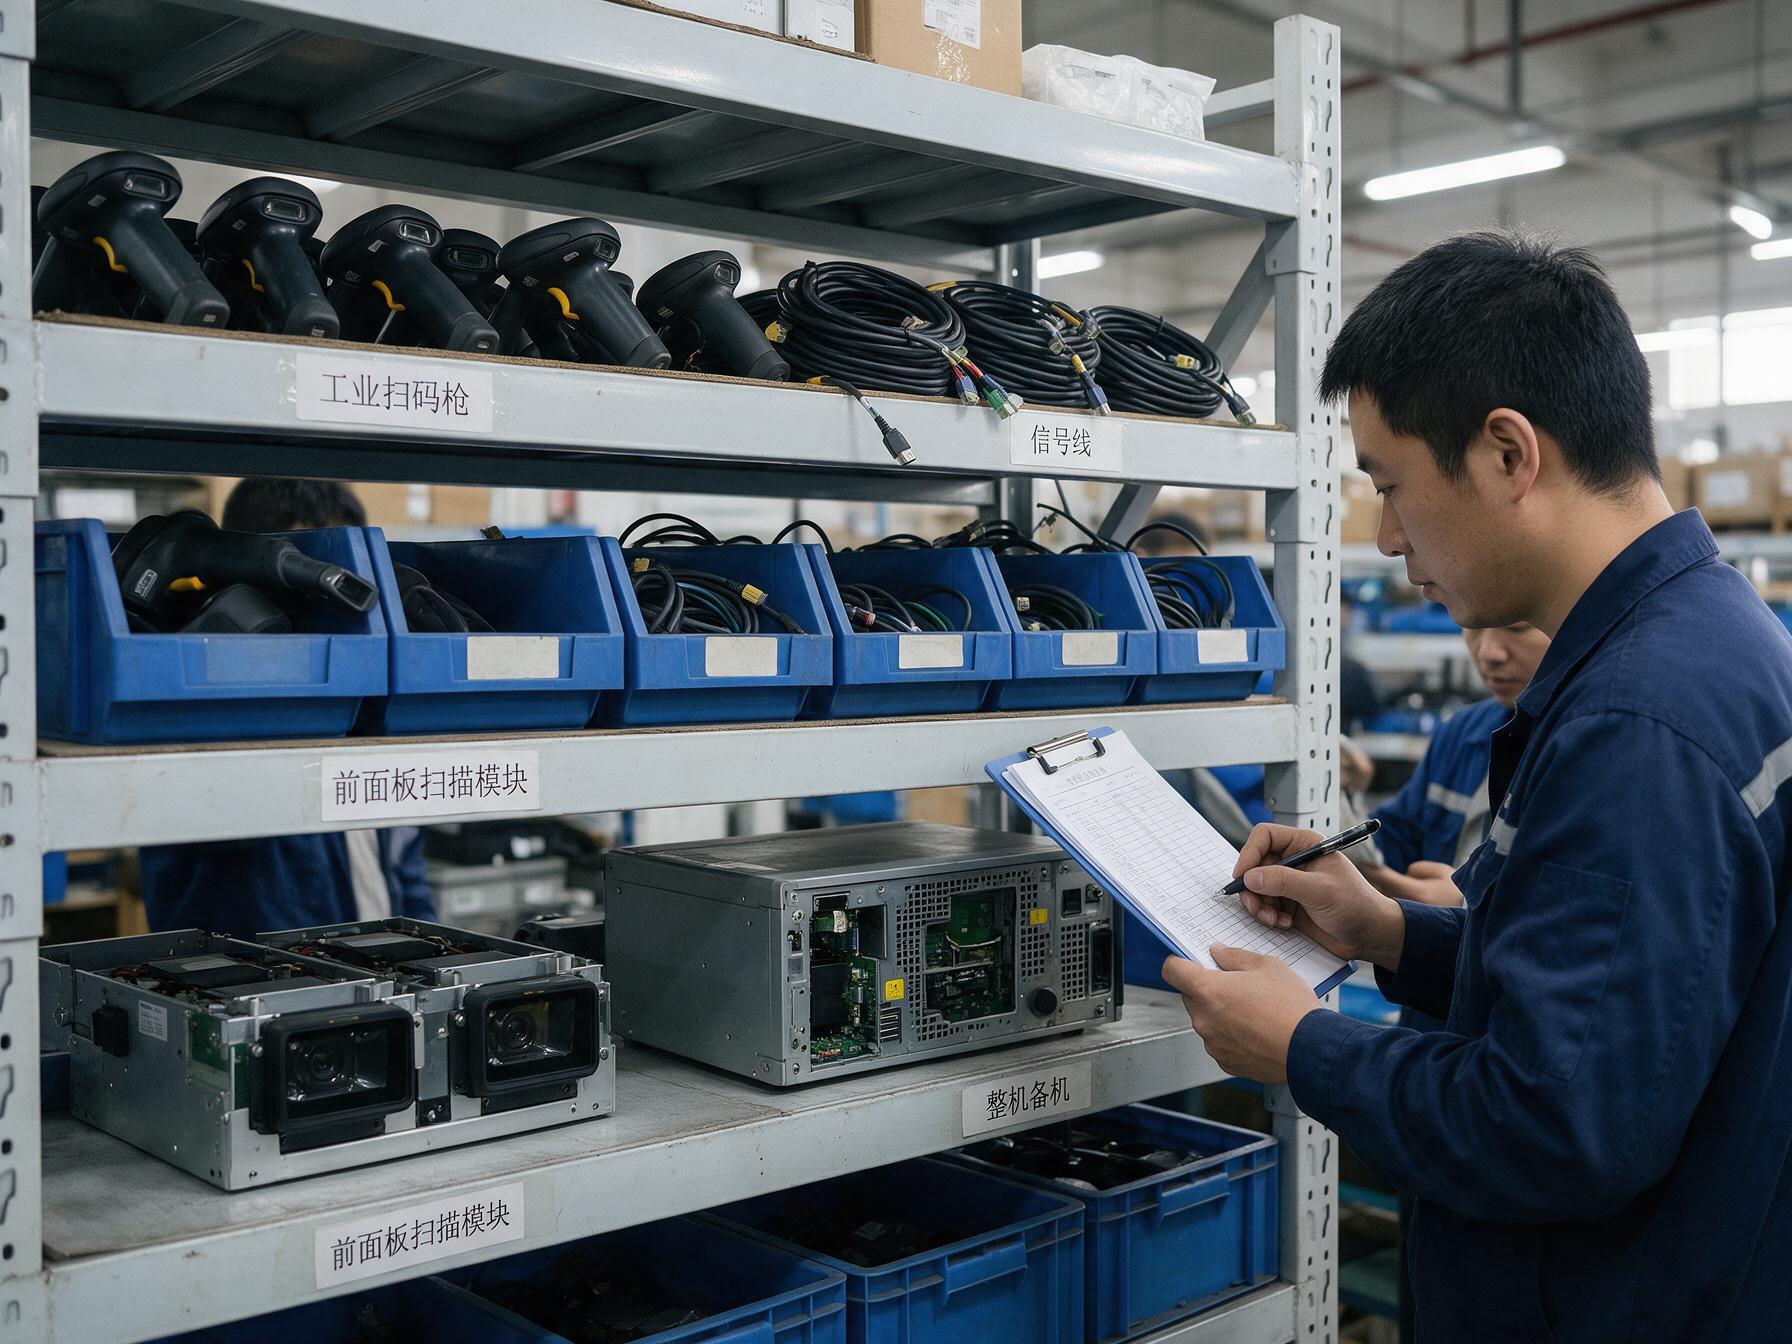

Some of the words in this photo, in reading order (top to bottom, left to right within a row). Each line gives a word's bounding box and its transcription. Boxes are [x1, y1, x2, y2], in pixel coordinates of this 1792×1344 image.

[319, 373, 470, 416] 工业扫码枪
[1030, 424, 1092, 458] 信号线
[332, 762, 528, 806] 前面板扫描模块
[986, 1076, 1070, 1122] 整机备机
[330, 1199, 511, 1272] 前面板扫描模块
